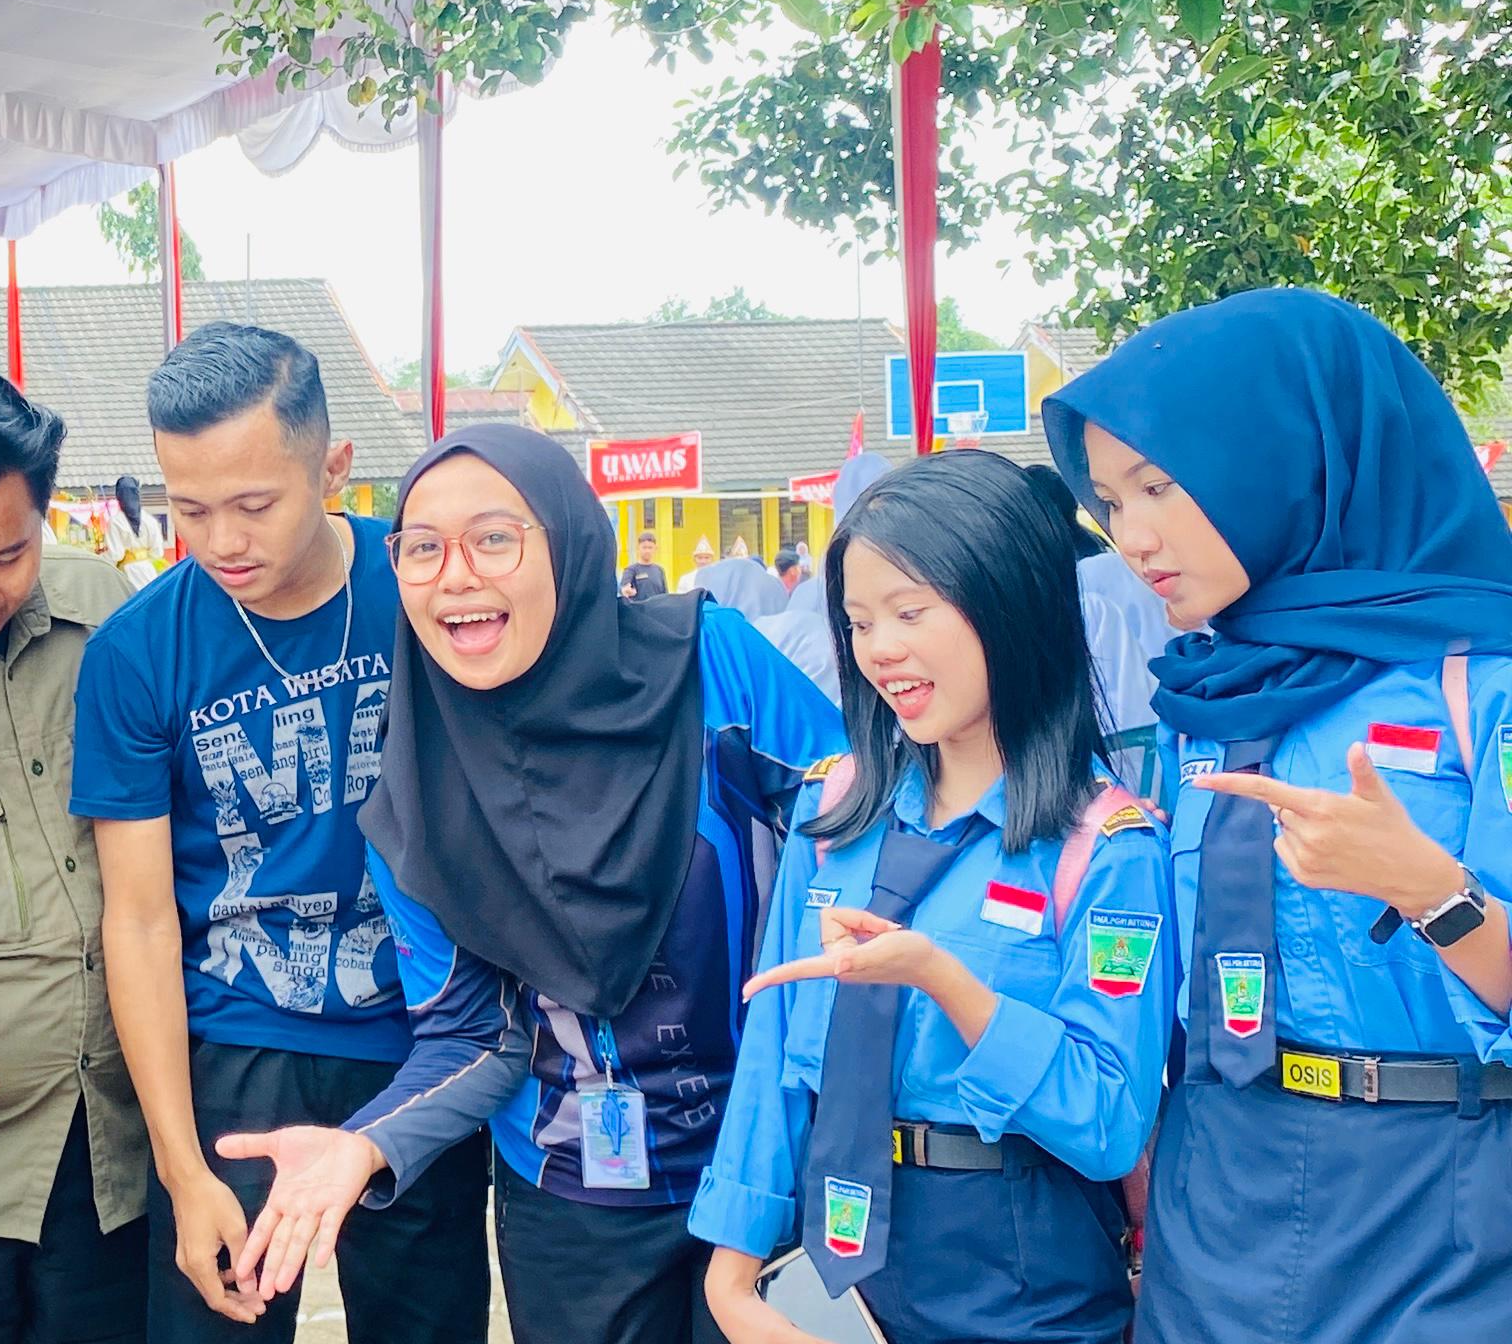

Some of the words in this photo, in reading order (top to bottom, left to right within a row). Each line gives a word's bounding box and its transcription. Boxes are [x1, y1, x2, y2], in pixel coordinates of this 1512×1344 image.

[602, 448, 687, 476] UWAIS
[190, 684, 277, 731] KOTA
[281, 653, 390, 699] WISATA
[1290, 1063, 1332, 1088] OSIS
